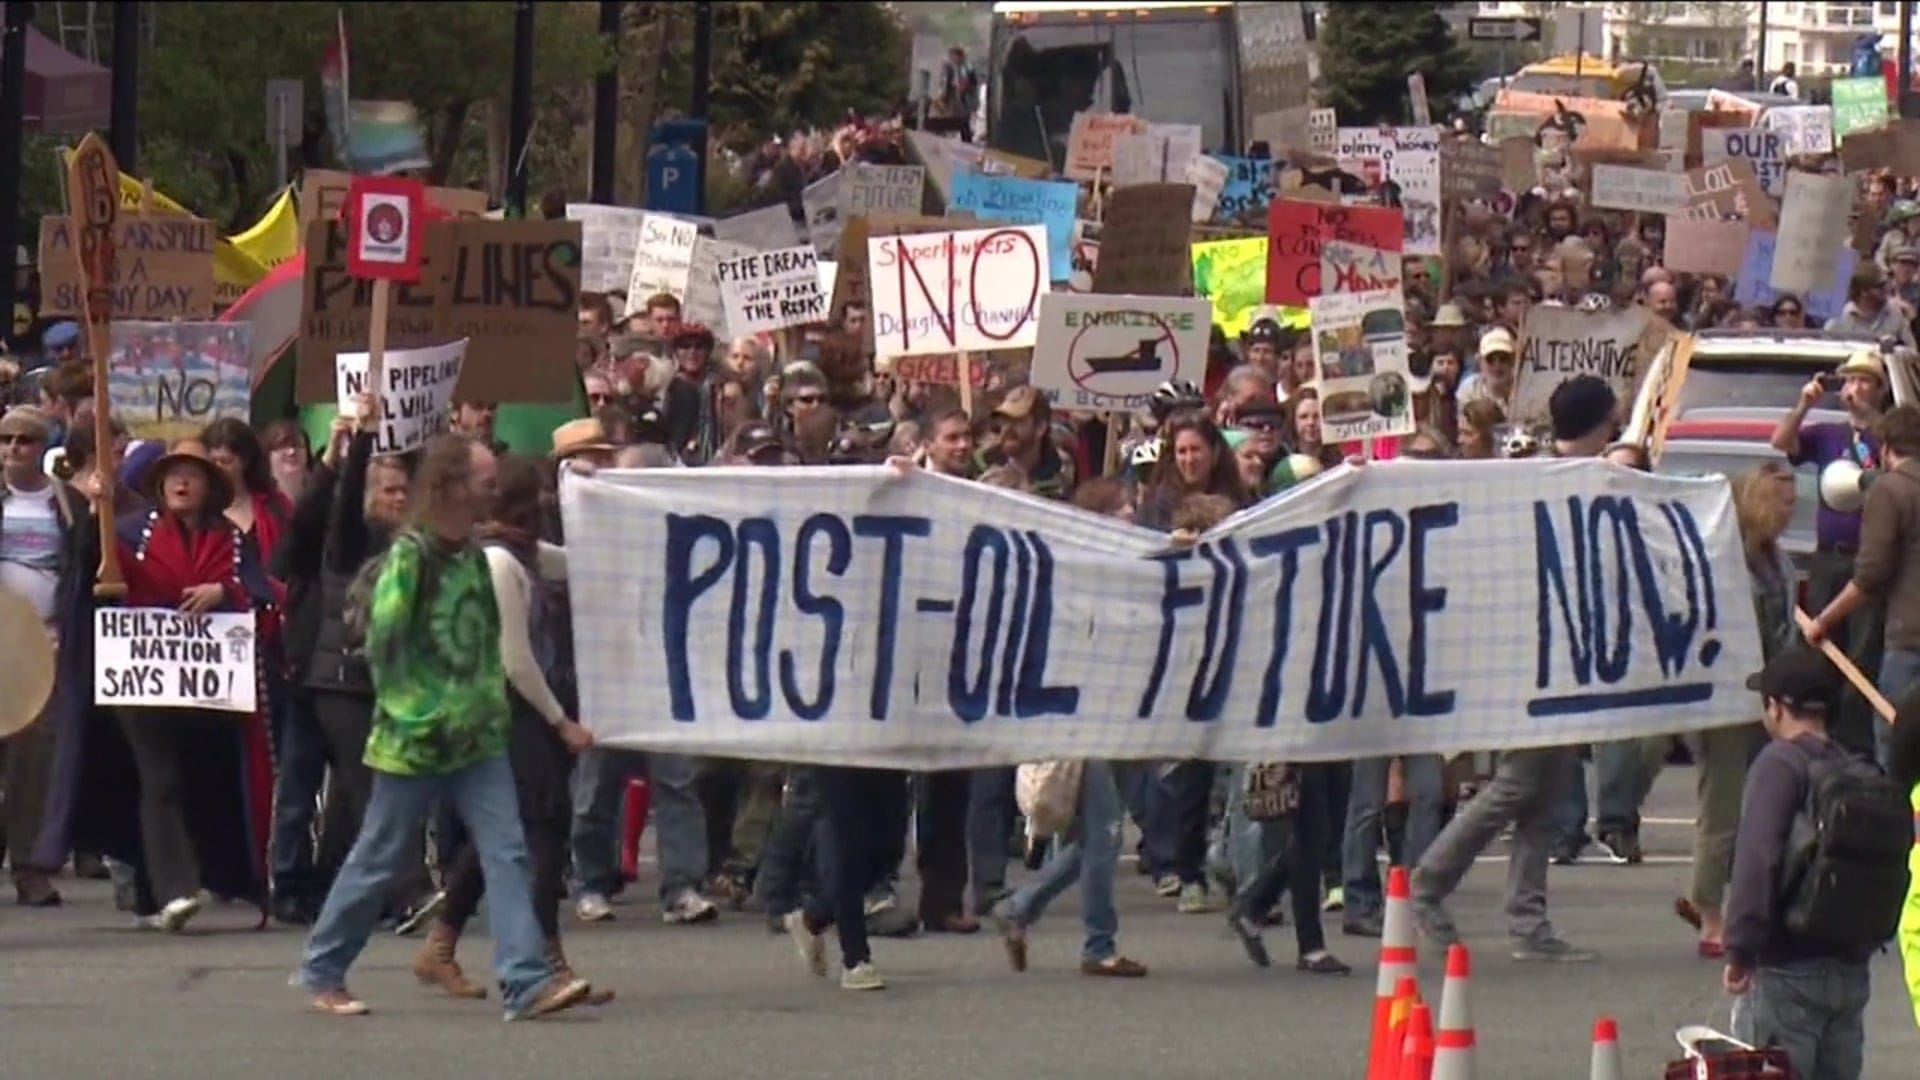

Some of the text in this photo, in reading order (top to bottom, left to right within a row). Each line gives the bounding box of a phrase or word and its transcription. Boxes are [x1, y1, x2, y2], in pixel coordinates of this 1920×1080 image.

[1726, 134, 1779, 157] OUR
[661, 167, 679, 189] P
[129, 257, 149, 282] A
[718, 257, 759, 281] PIPE
[763, 251, 817, 277] DREAM
[896, 229, 1040, 350] NO
[742, 303, 775, 321] THE
[1523, 335, 1639, 379] ALTERNATIVE
[158, 369, 216, 423] NO
[101, 611, 214, 641] HEILTSUK
[663, 495, 1722, 728] POST-OIL FUTURE NOW!
[130, 638, 223, 664] NATION
[102, 665, 165, 698] SAYS
